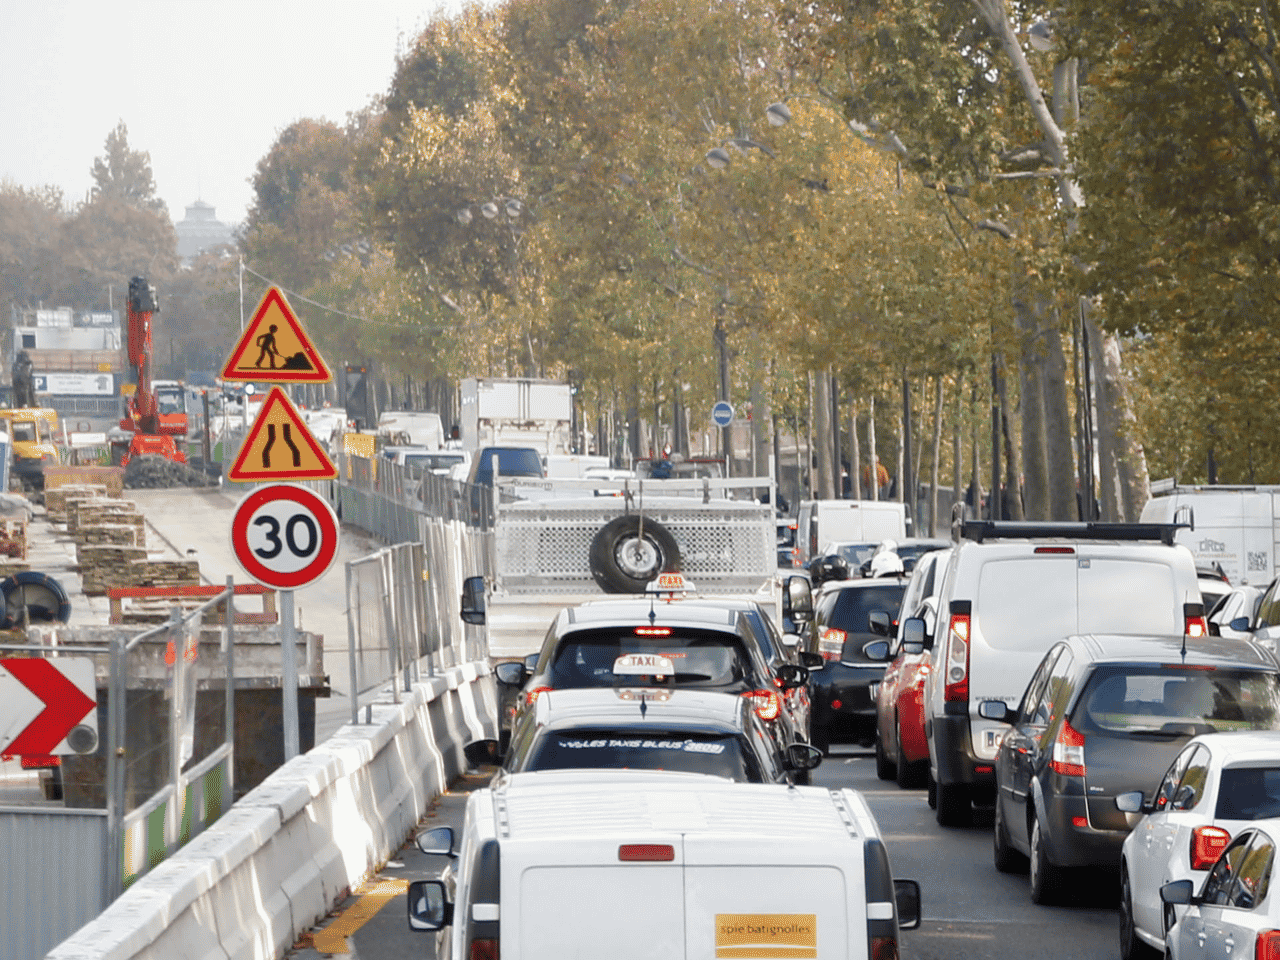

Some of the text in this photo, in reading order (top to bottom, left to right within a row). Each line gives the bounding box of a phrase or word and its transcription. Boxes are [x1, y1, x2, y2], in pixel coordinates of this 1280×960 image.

[253, 513, 318, 560] 30
[630, 656, 656, 667] TAXI
[582, 740, 607, 749] LES
[608, 740, 642, 748] TAXIS
[642, 740, 683, 749] BLEUS
[721, 925, 810, 936] spie batignolles
